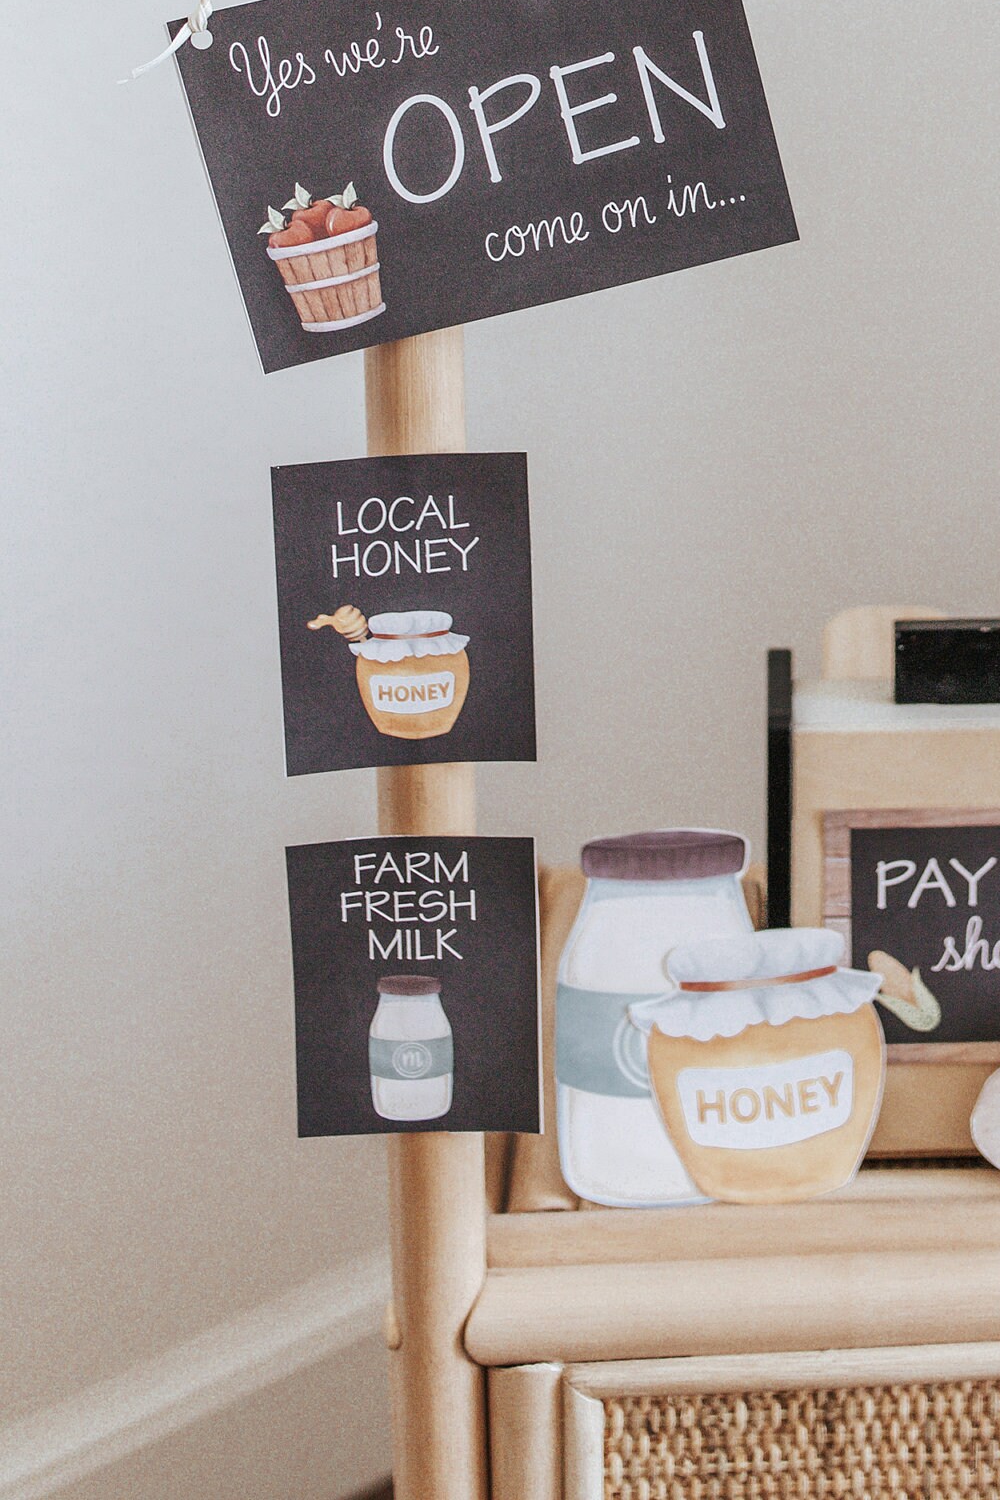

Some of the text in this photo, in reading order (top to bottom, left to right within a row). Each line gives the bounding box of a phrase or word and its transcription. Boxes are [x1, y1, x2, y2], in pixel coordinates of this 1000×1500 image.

[229, 11, 440, 118] Yes we're
[382, 29, 726, 205] OPEN
[484, 174, 746, 262] come on in...
[336, 494, 470, 536] LOCAL
[331, 536, 480, 579] HONEY
[377, 682, 451, 703] HONEY
[353, 850, 470, 885] FARM
[875, 856, 997, 910] PAY
[340, 889, 477, 923] FRESH
[368, 928, 463, 961] MILK
[695, 1070, 846, 1126] HONEY
